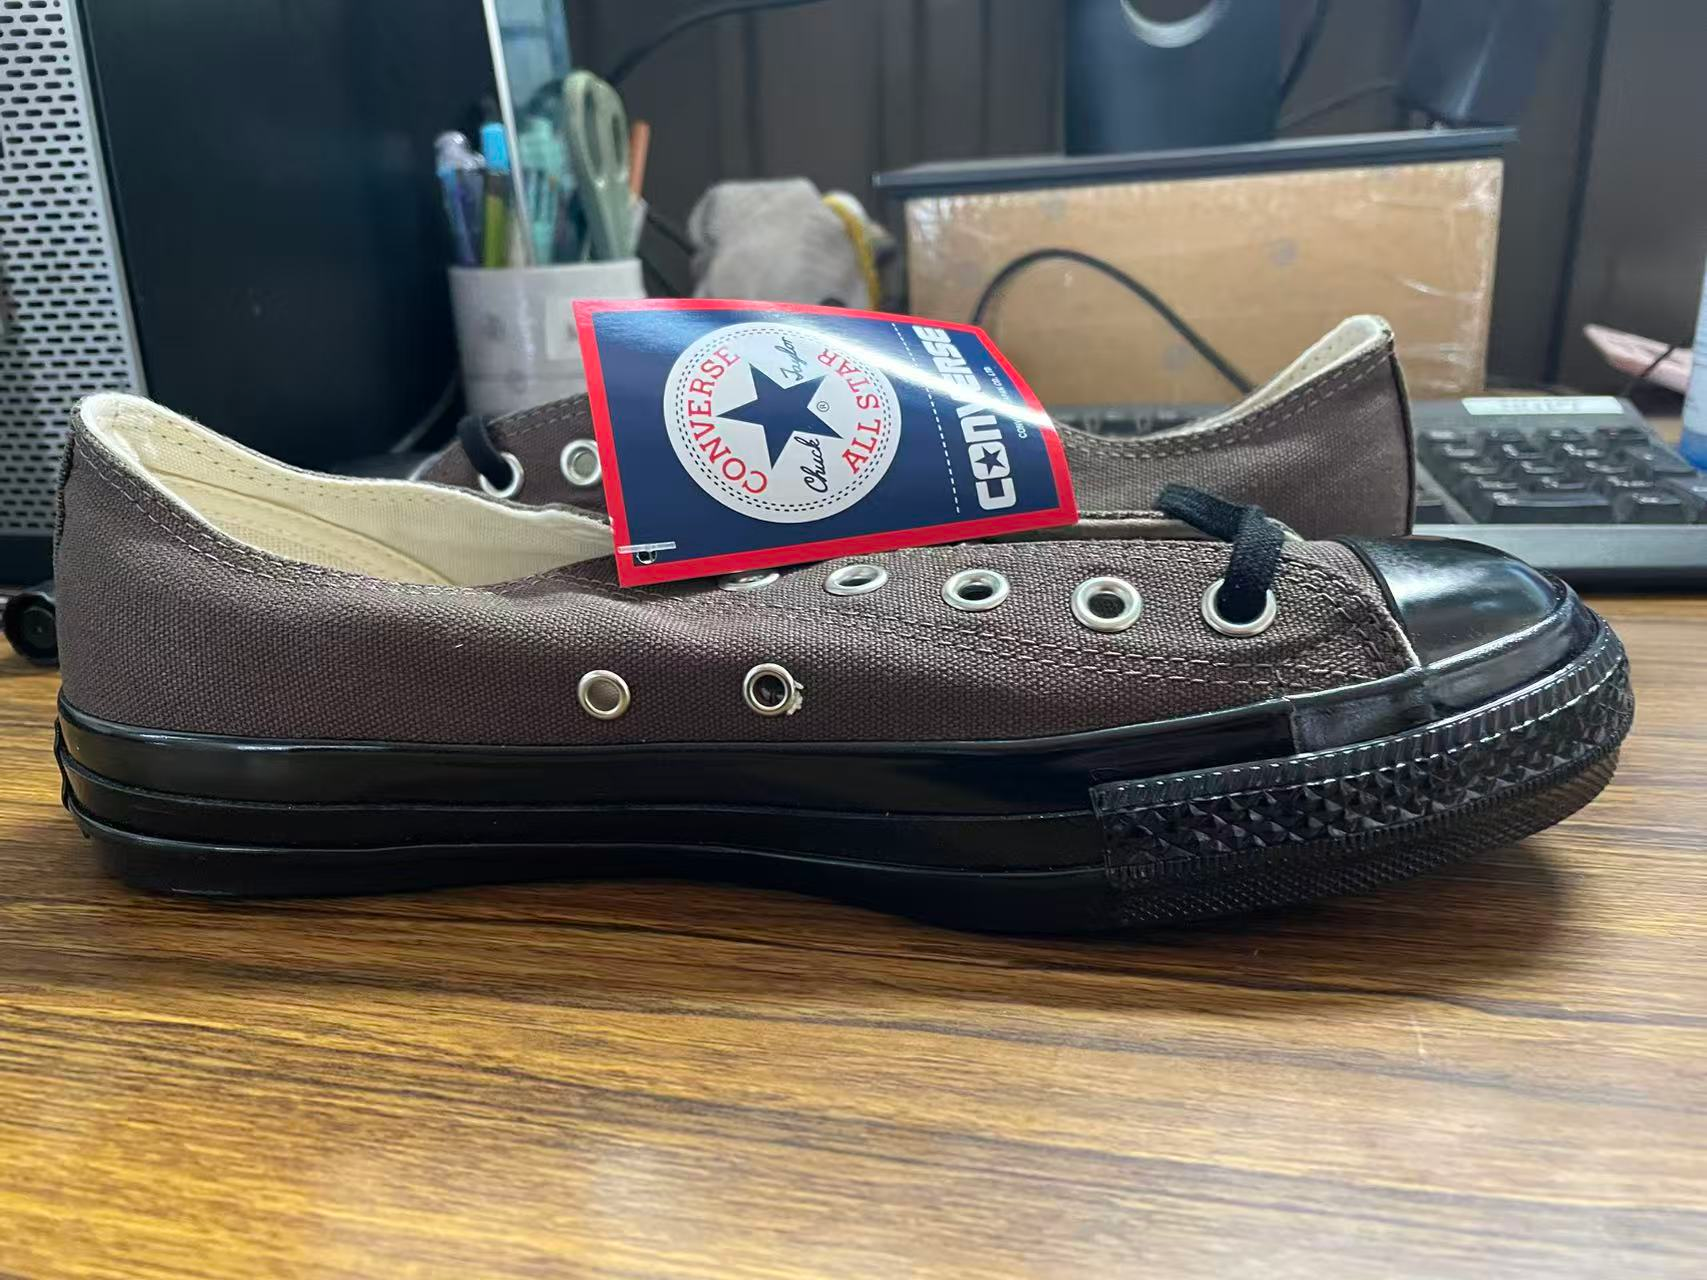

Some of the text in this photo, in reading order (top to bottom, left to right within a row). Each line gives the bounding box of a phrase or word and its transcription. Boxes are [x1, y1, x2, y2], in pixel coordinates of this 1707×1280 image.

[687, 346, 768, 494] CONVERSE
[774, 336, 808, 381] Taylor
[816, 348, 882, 474] ALL STAR
[912, 325, 1017, 511] CONVERSE
[793, 435, 828, 493] Chuck
